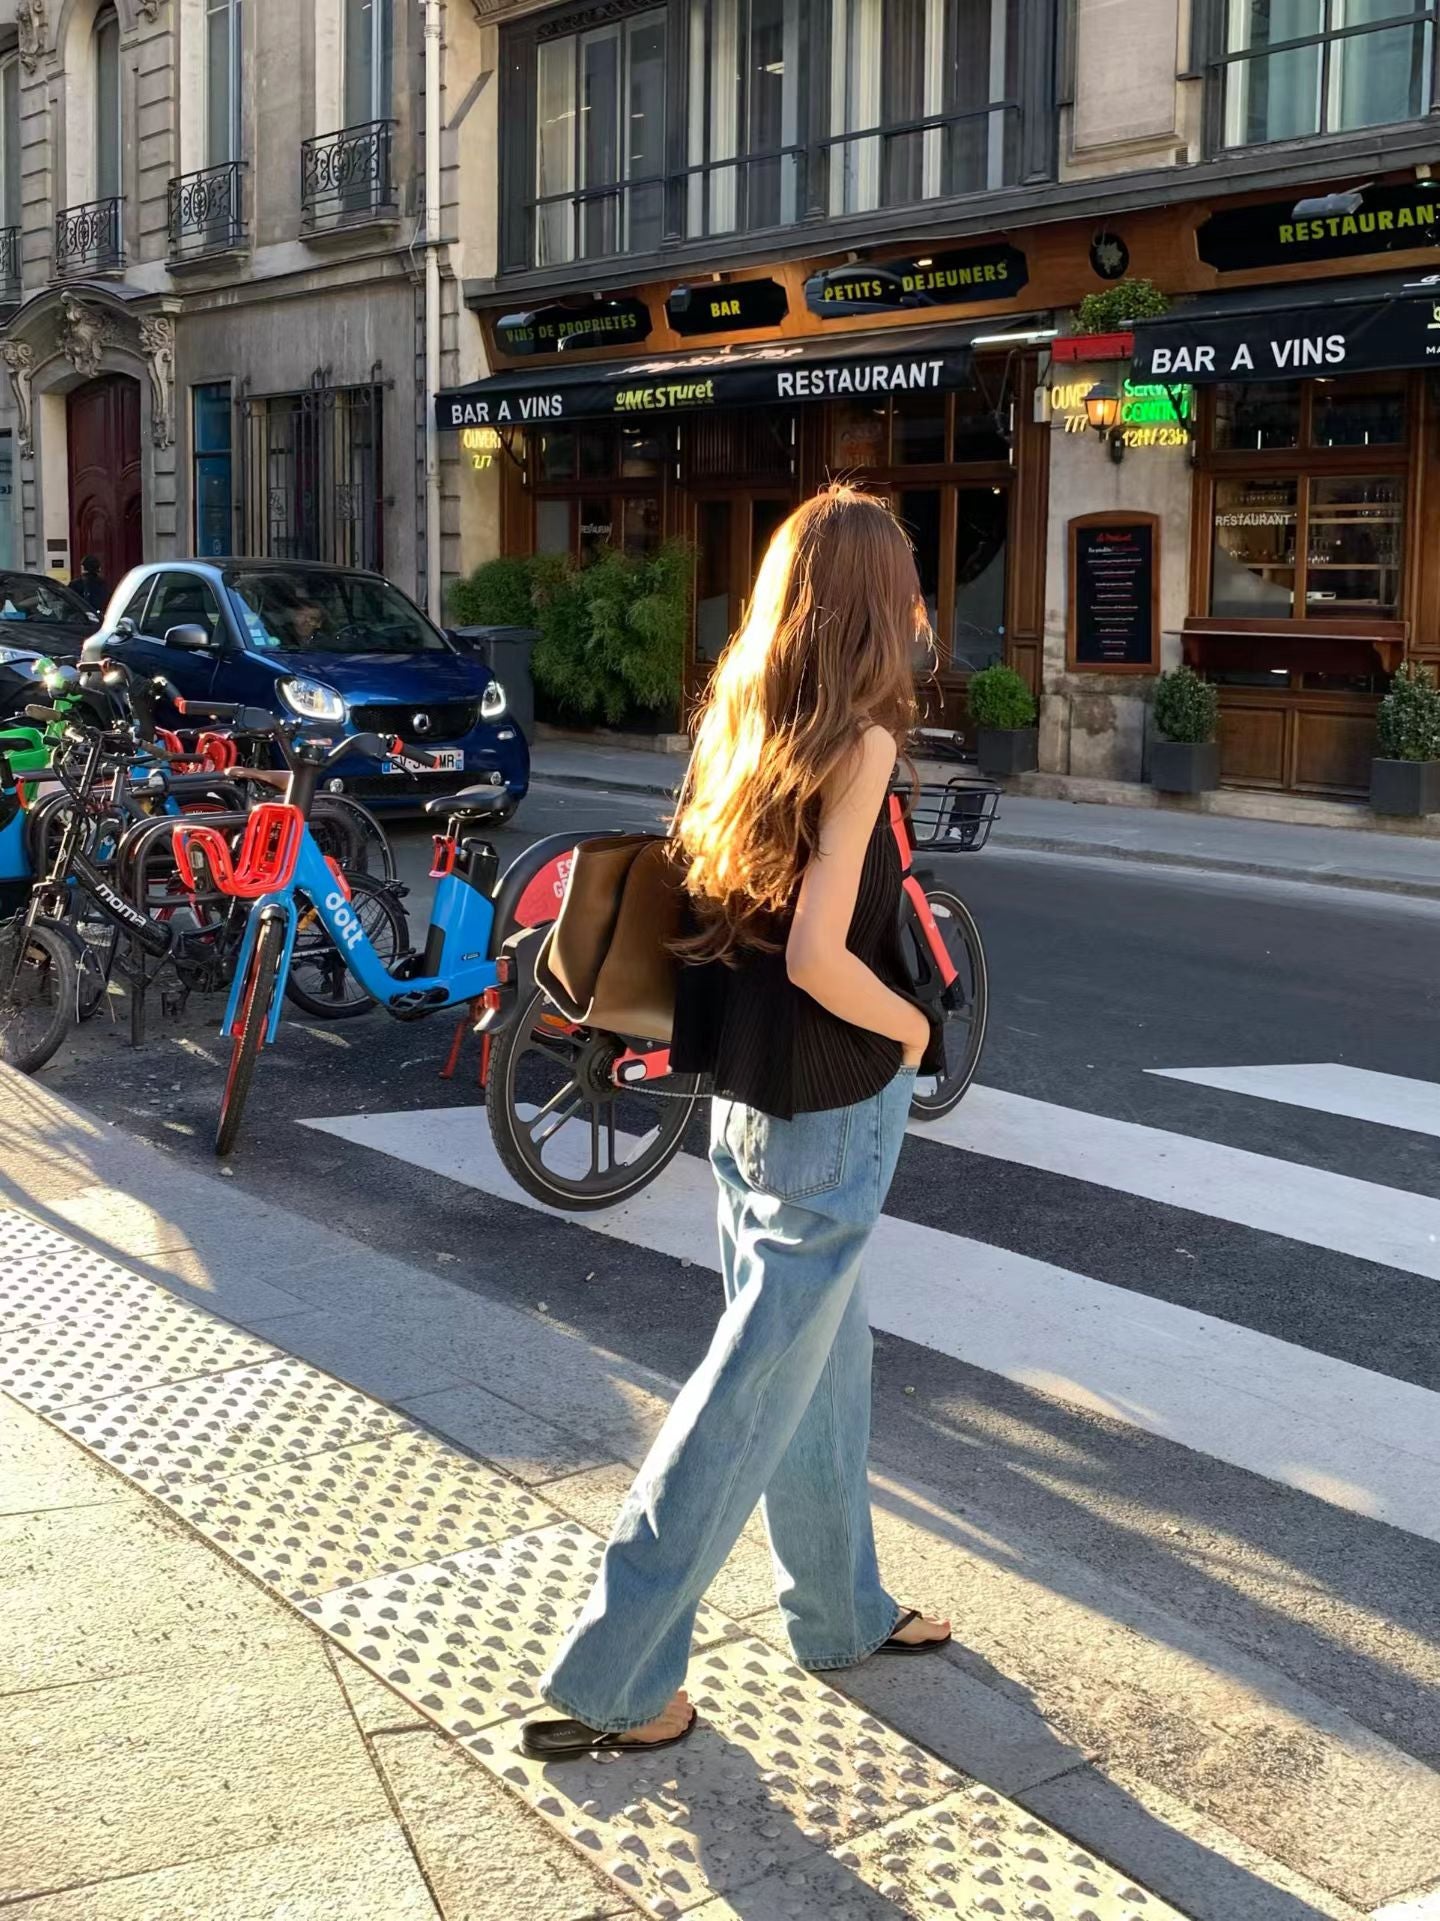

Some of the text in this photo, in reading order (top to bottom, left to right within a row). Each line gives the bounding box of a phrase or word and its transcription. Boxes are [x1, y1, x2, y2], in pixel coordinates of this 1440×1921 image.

[1279, 204, 1440, 243] RESTAURAN
[824, 280, 882, 302] PETITS
[902, 263, 1008, 292] DEJEUNERS
[710, 300, 741, 318] BAR
[505, 314, 637, 343] VINS DE PROPRIETES
[1151, 334, 1346, 374] BAR A VINS
[777, 360, 944, 397] RESTAURANT
[451, 395, 563, 425] BAR A VINS
[1051, 382, 1099, 410] OUVE
[1064, 415, 1089, 433] 7/7
[1215, 512, 1292, 527] RESTAURANT
[95, 883, 147, 928] moma
[325, 892, 364, 951] dott
